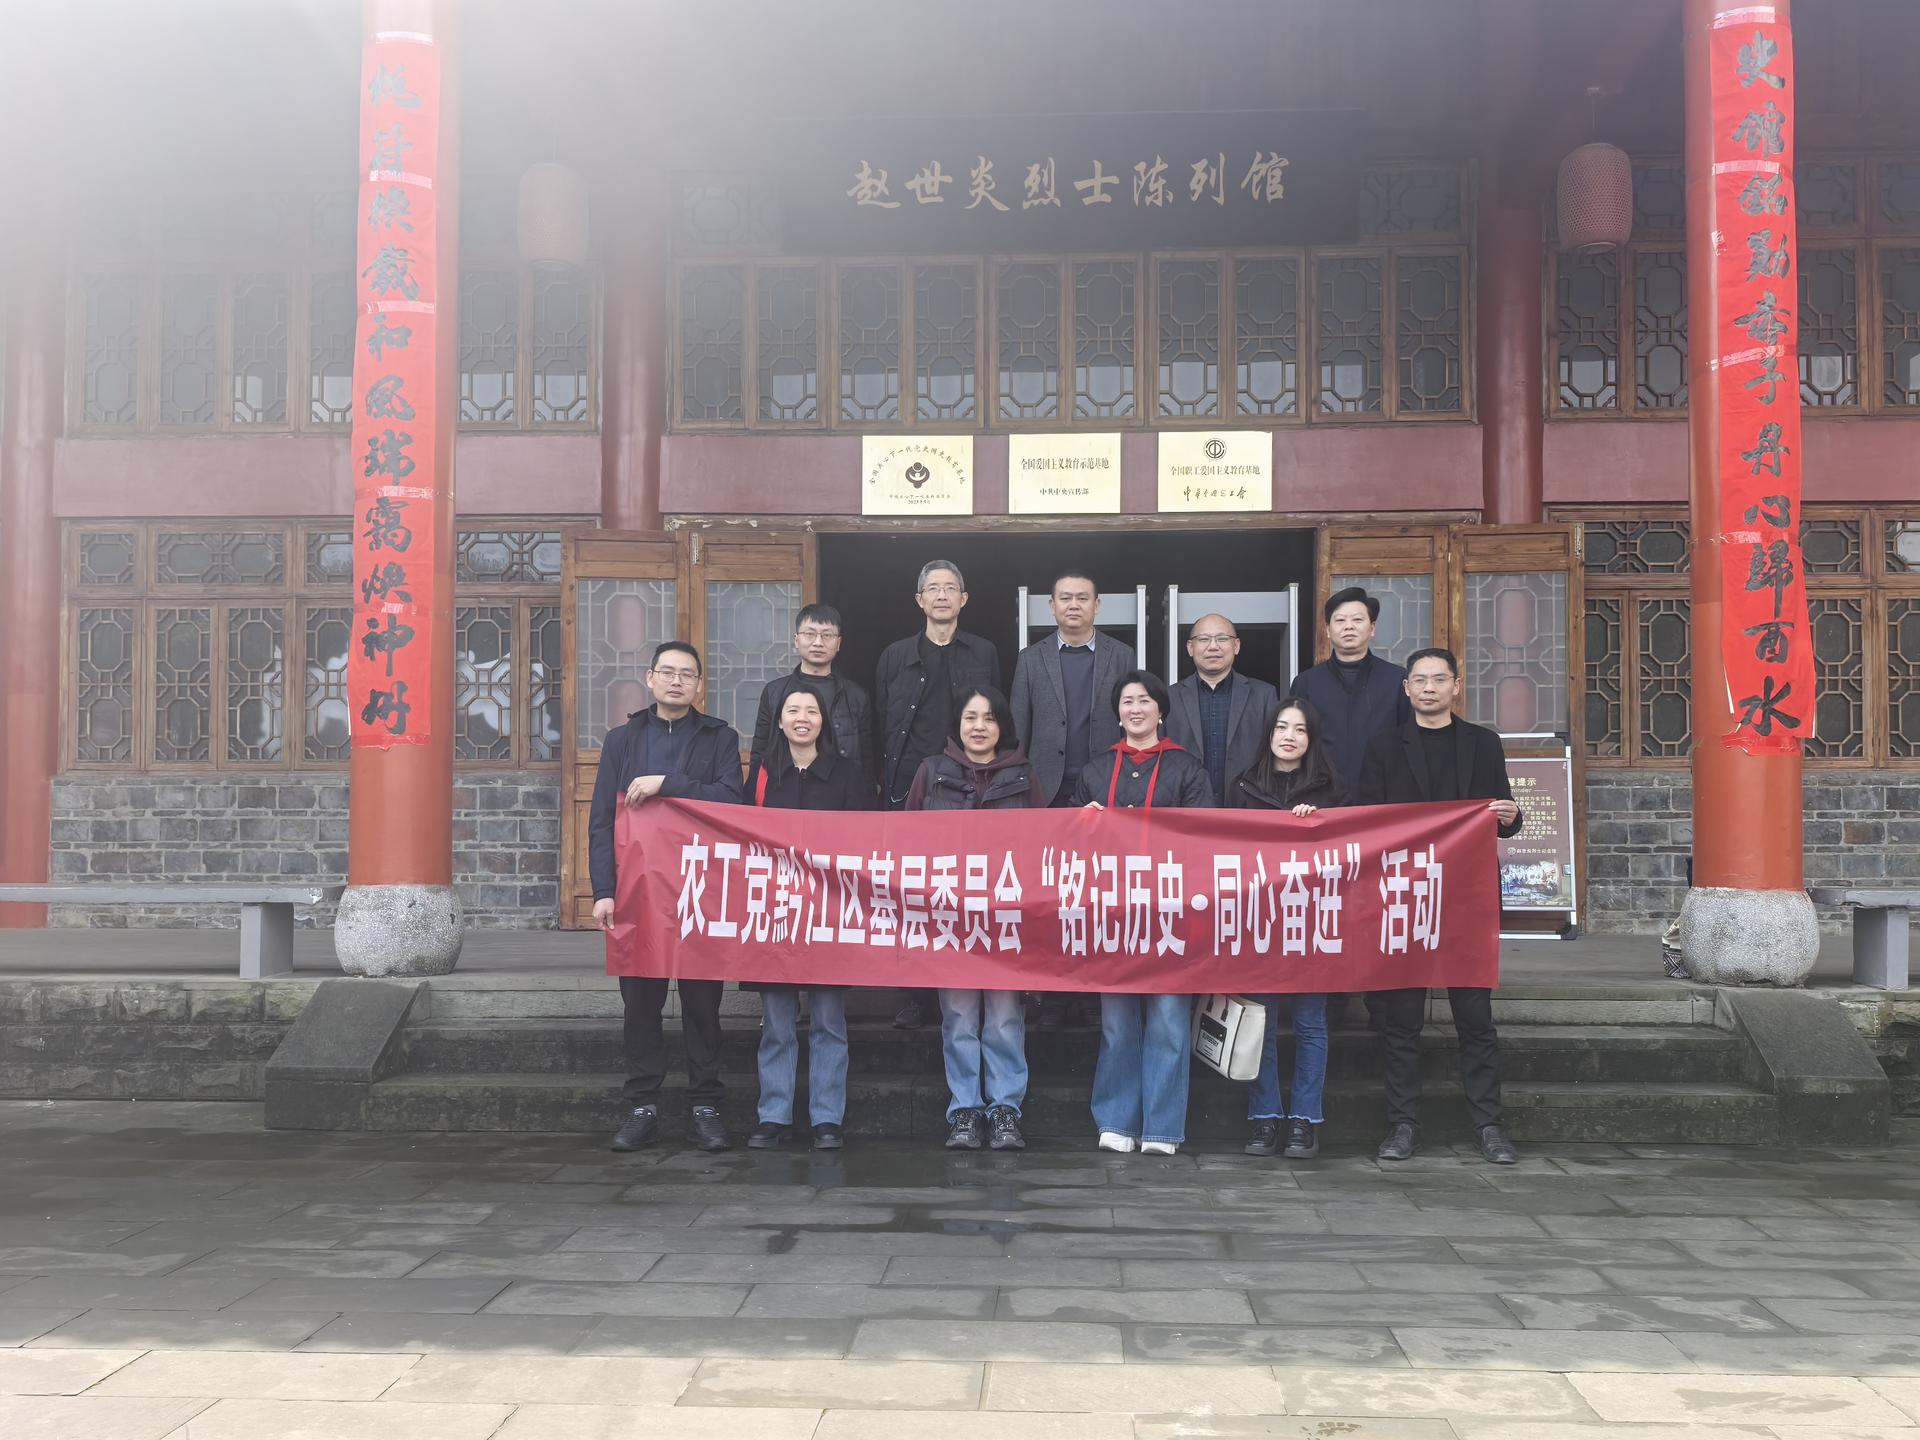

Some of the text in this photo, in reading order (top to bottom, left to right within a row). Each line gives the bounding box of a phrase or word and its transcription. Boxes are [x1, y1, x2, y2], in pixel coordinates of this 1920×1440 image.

[846, 151, 1290, 211] 赵世炎烈士陈列馆
[1020, 457, 1110, 470] 全国爱国主义教育示范基地
[1170, 465, 1261, 476] 全国职工爱国主义教育基地
[1039, 487, 1090, 496] 中共中央宣传部
[676, 832, 1022, 955] 农工党黔江区基层委员会
[1378, 842, 1443, 955] 活动
